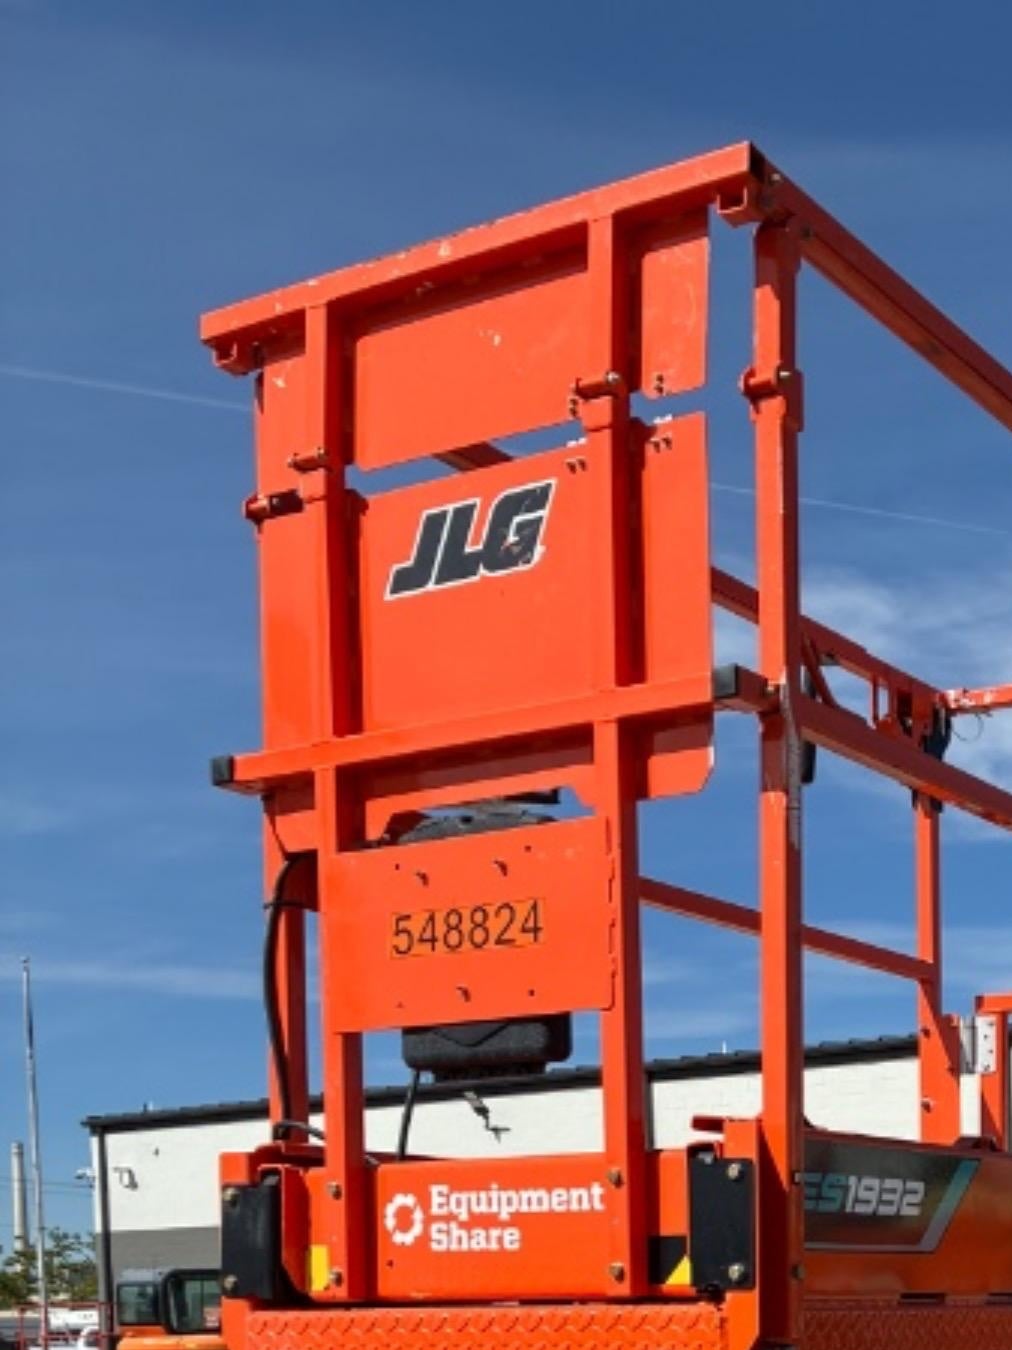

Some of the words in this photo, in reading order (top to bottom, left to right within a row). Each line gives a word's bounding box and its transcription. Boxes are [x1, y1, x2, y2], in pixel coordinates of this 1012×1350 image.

[384, 477, 557, 601] JLG
[392, 899, 543, 955] 548824
[430, 1182, 604, 1221] Equipment
[430, 1221, 521, 1252] Share
